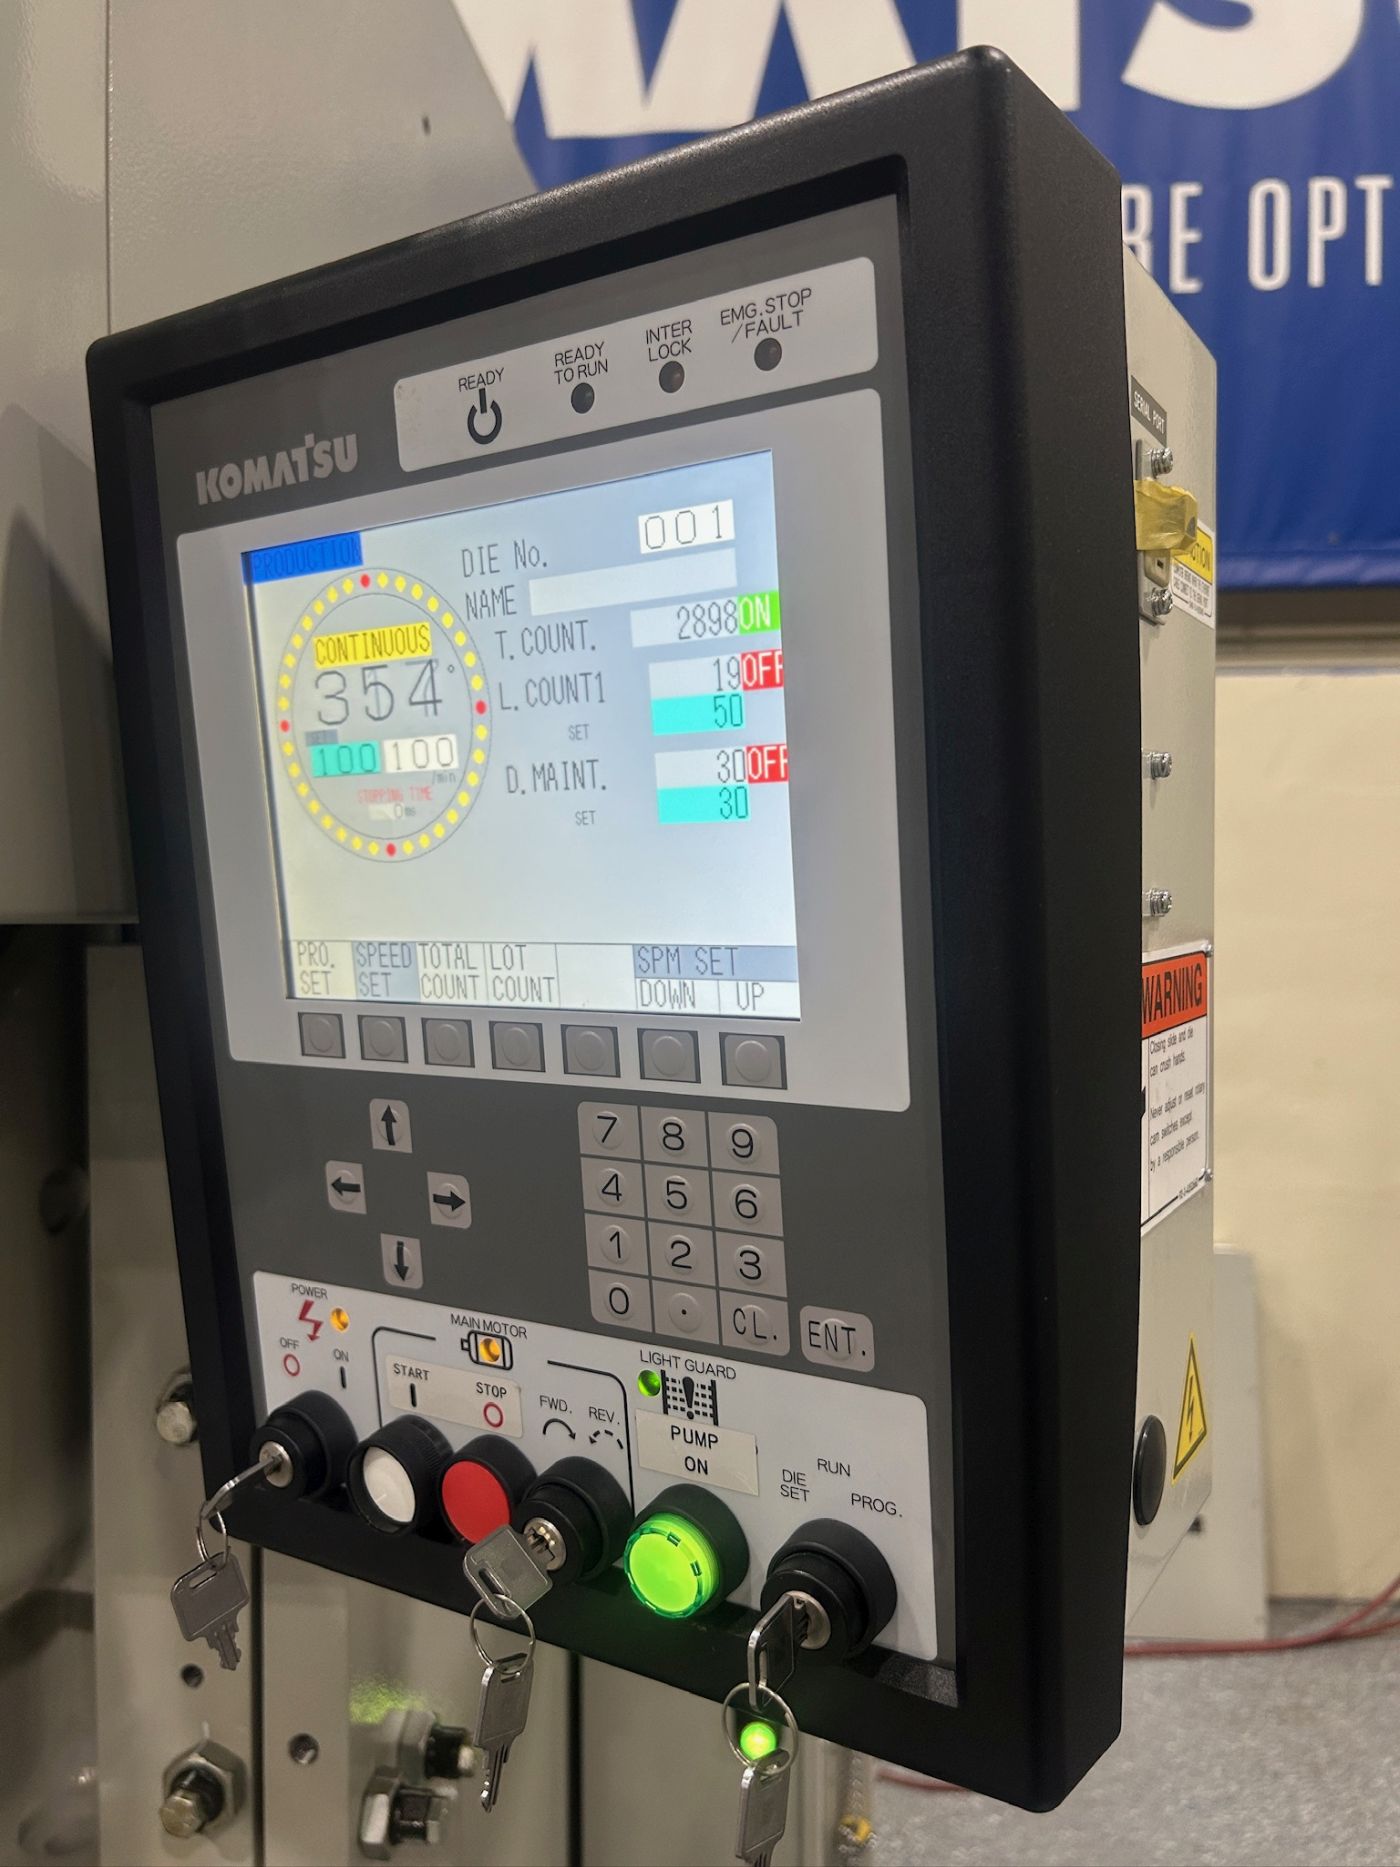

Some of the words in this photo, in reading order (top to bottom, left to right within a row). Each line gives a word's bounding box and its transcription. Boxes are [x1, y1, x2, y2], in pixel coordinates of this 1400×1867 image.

[720, 288, 812, 326] EMG.STOP
[645, 319, 693, 344] INTER
[731, 310, 804, 344] /FAULT
[554, 341, 605, 367] READY
[648, 338, 692, 362] LOCK
[458, 367, 505, 392] READY
[554, 368, 576, 385] TO
[578, 359, 608, 380] RUN
[1134, 390, 1151, 423] SERIAL
[1153, 412, 1165, 436] PORT
[196, 433, 359, 505] KOMATSU
[644, 504, 724, 549] 001
[253, 536, 363, 575] PRODUCTION
[461, 543, 500, 578] DIE
[514, 538, 548, 570] No.
[465, 584, 518, 621] NAME
[677, 599, 738, 640] 2898
[739, 594, 771, 631] ON
[315, 624, 431, 665] CONTINUOUS
[713, 656, 741, 692] 19
[714, 693, 744, 728] 50
[568, 724, 590, 741] SET
[319, 742, 377, 776] 100
[393, 737, 454, 770] 100
[716, 749, 746, 784] 30
[719, 786, 749, 820] 30
[575, 811, 596, 827] SET
[297, 941, 336, 969] PRO.
[356, 941, 412, 969] SPEED
[418, 943, 479, 970] TOTAL
[489, 944, 526, 970] LOT
[637, 946, 681, 974] SPM
[695, 946, 739, 976] SET
[300, 970, 332, 996] SET
[359, 971, 392, 998] SET
[421, 974, 480, 1000] COUNT
[492, 976, 555, 1003] COUNT
[639, 979, 696, 1010] DOWN
[736, 982, 764, 1011] UP
[1142, 962, 1203, 1025] WARNING
[596, 1114, 618, 1143] 7
[662, 1121, 685, 1151] 8
[731, 1128, 754, 1158] 9
[601, 1172, 623, 1202] 4
[666, 1180, 688, 1210] 5
[735, 1189, 758, 1219] 6
[609, 1231, 621, 1258] 1
[670, 1240, 692, 1269] 2
[739, 1249, 762, 1280] 3
[291, 1283, 328, 1300] POWER
[609, 1286, 629, 1315] 0
[450, 1313, 481, 1331] MAIN
[482, 1318, 528, 1340] MOTOR
[732, 1307, 778, 1341] CL.
[807, 1319, 867, 1357] ENT.
[280, 1337, 299, 1350] OFF
[333, 1349, 349, 1362] ON
[393, 1363, 430, 1381] START
[640, 1349, 681, 1369] LIGHT
[684, 1359, 737, 1380] GUARD
[476, 1382, 507, 1399] STOP
[539, 1395, 573, 1414] FWD.
[588, 1406, 621, 1425] REV.
[670, 1425, 719, 1449] PUMP
[684, 1456, 708, 1475] ON
[782, 1469, 807, 1487] DIE
[817, 1457, 851, 1477] RUN
[780, 1485, 810, 1501] SET
[851, 1492, 903, 1518] PROG.
